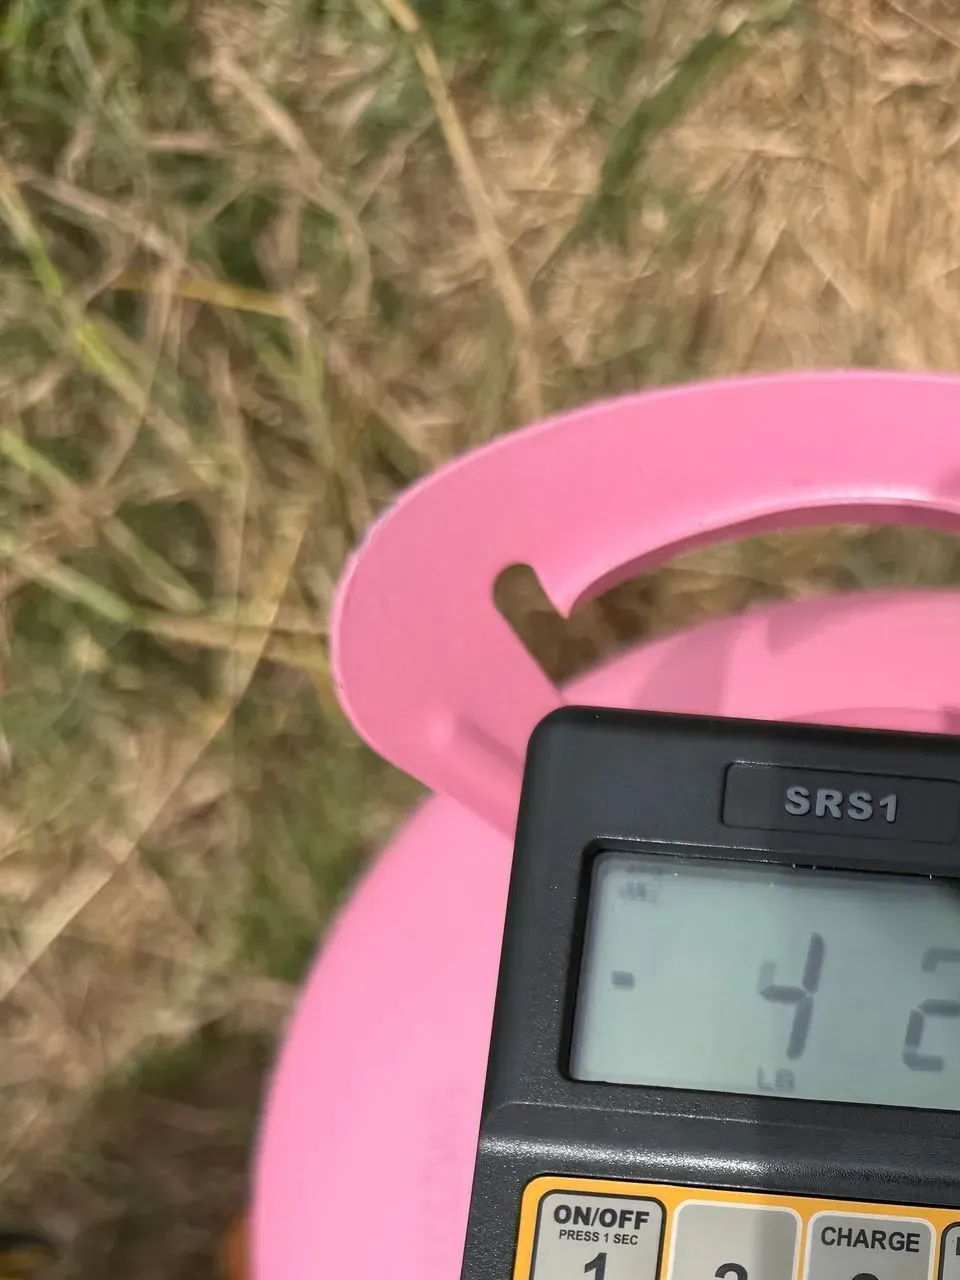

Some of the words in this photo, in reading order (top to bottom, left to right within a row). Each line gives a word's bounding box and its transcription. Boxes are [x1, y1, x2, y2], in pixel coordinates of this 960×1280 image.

[784, 786, 900, 825] SRS1
[758, 931, 824, 1061] 4
[553, 1203, 650, 1231] ON/OFF
[558, 1228, 598, 1243] PRESS
[612, 1231, 639, 1246] SEC
[820, 1226, 920, 1253] CHARGE
